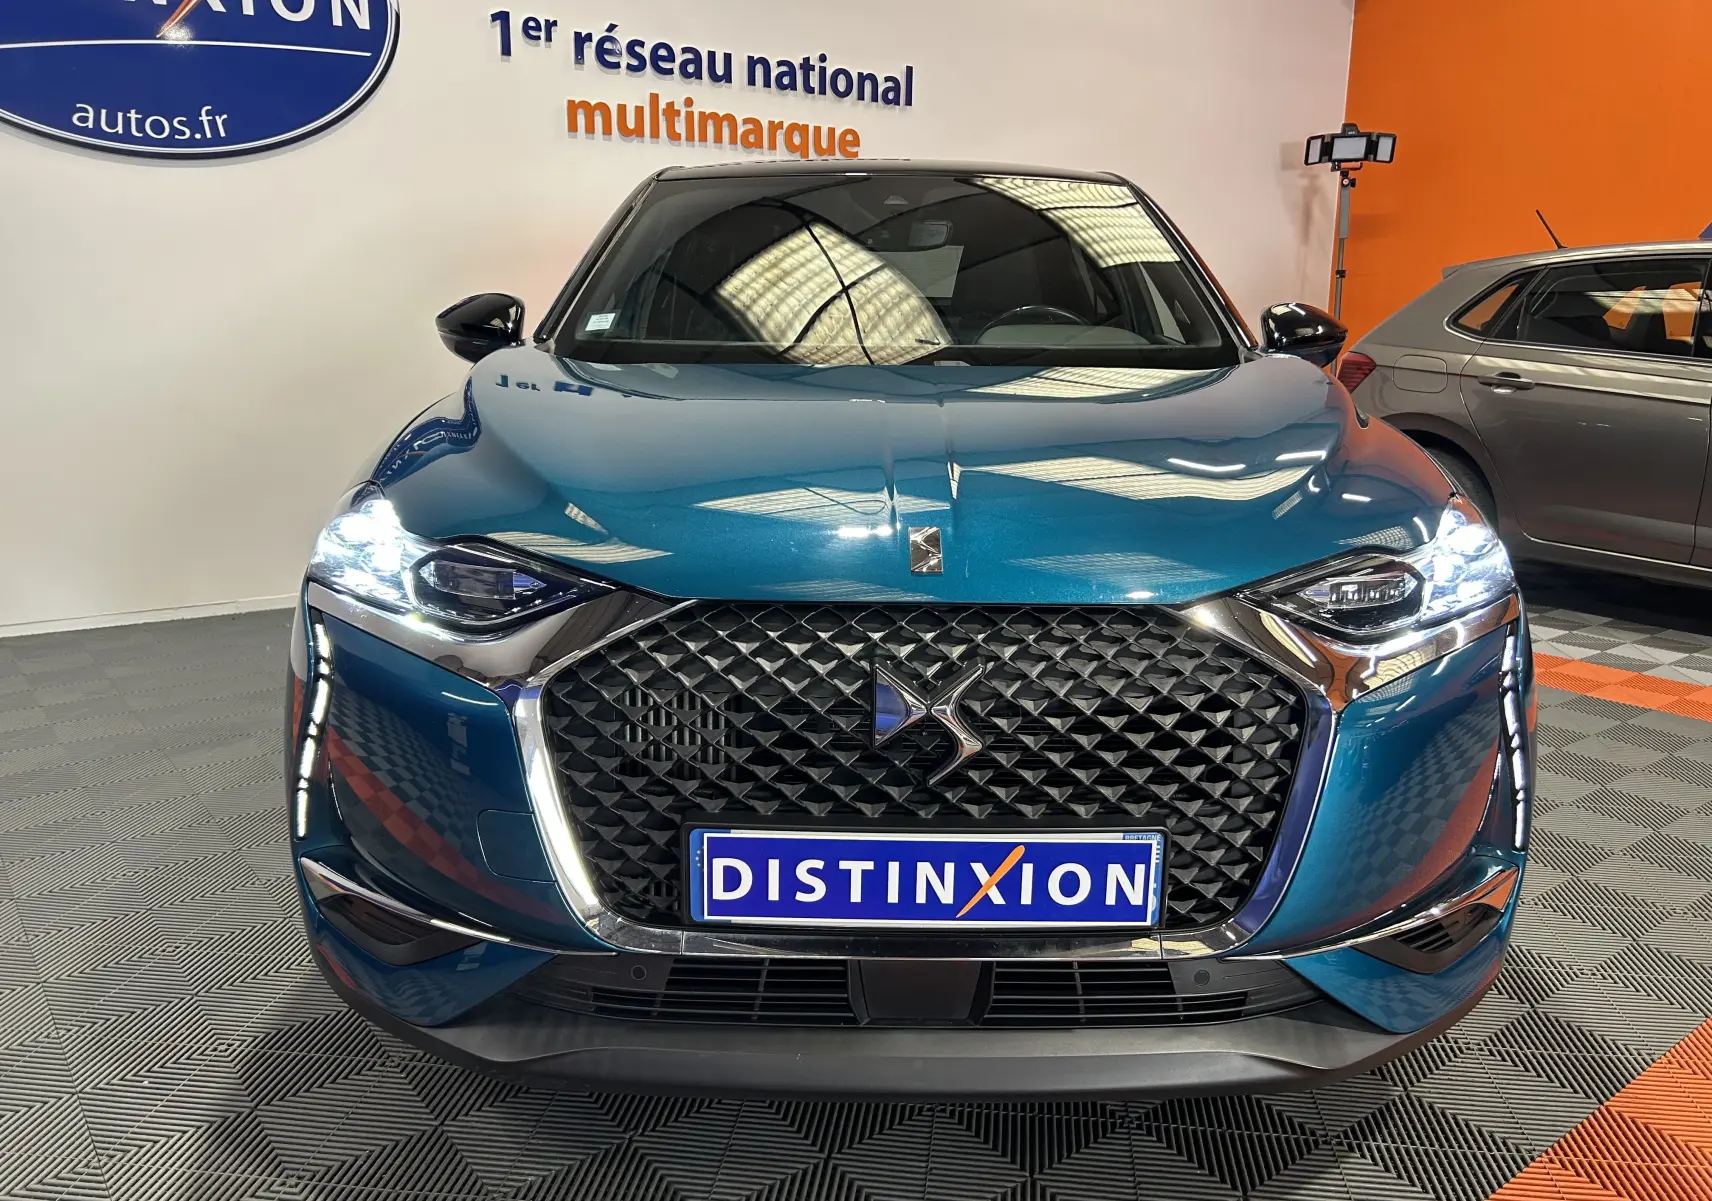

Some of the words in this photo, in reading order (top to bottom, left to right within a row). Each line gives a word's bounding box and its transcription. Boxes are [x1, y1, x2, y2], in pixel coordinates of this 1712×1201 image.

[490, 10, 558, 57] 1er
[573, 23, 733, 84] réseau
[747, 53, 914, 107] national
[72, 103, 228, 140] autos.fr
[567, 93, 861, 159] multimarque
[712, 846, 1147, 917] DISTINXION
